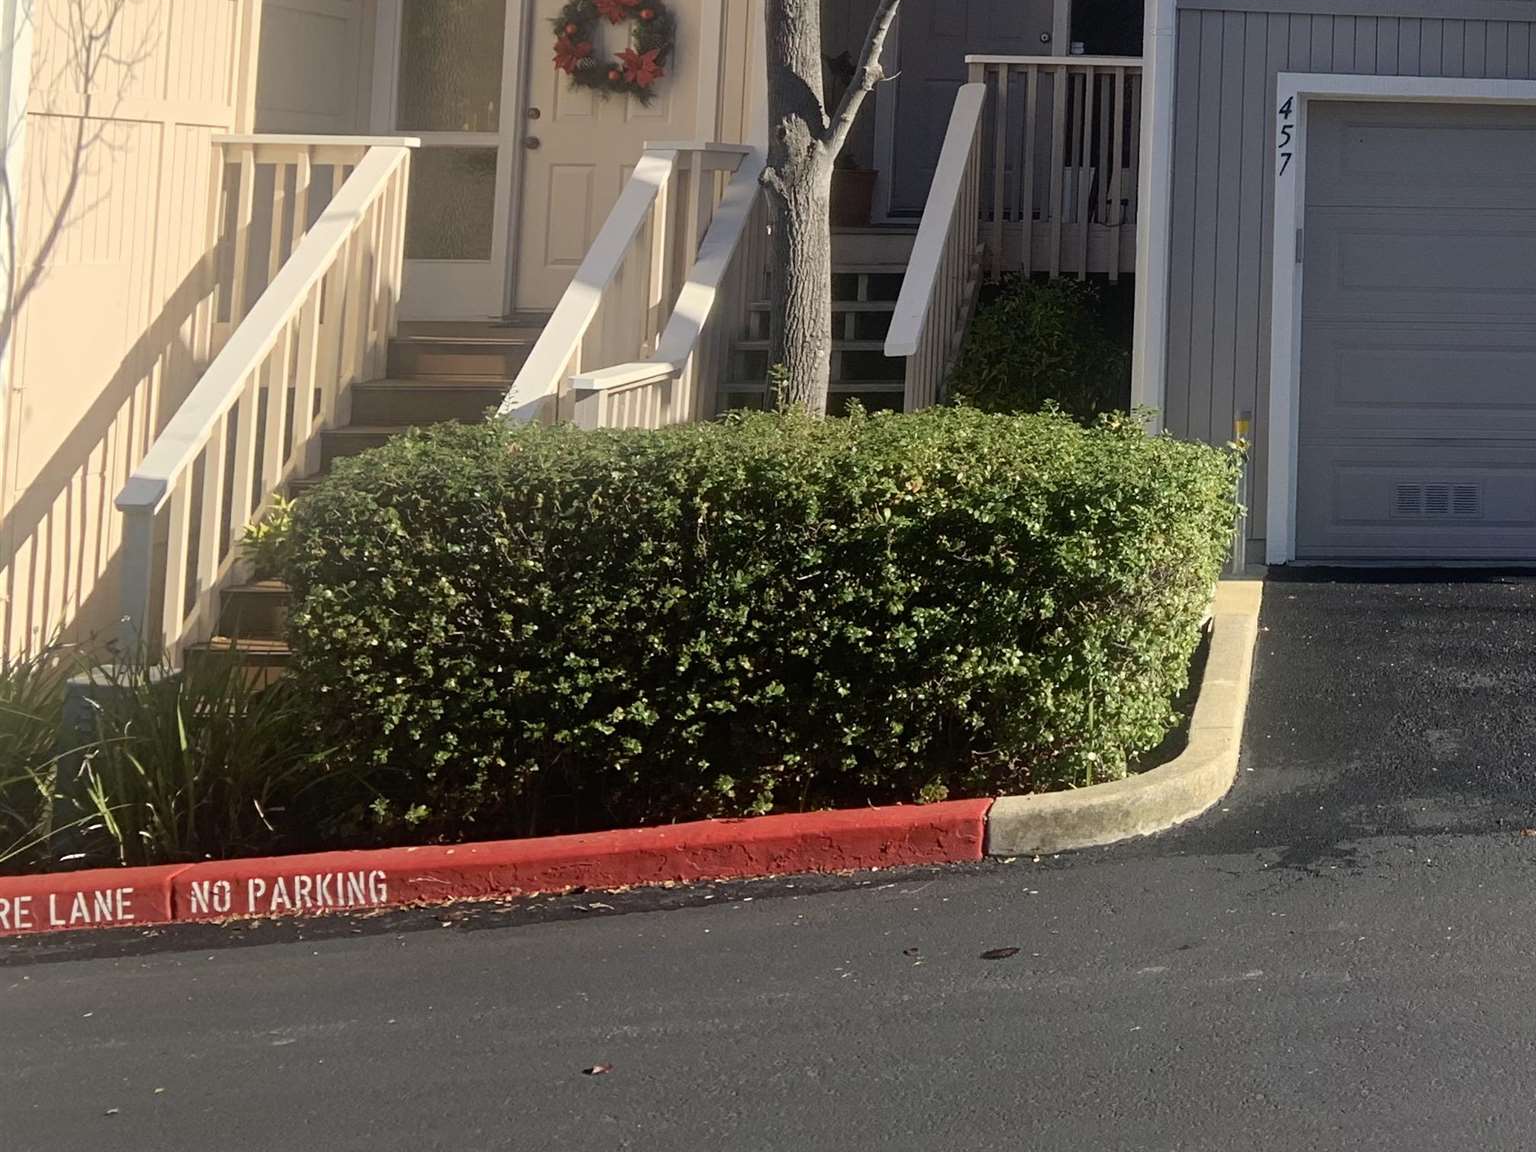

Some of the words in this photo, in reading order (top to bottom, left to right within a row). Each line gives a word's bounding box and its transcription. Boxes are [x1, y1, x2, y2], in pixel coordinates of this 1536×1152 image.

[1278, 96, 1294, 176] 457
[49, 887, 135, 925] LANE
[190, 879, 231, 914] NO
[248, 869, 388, 913] PARKING
